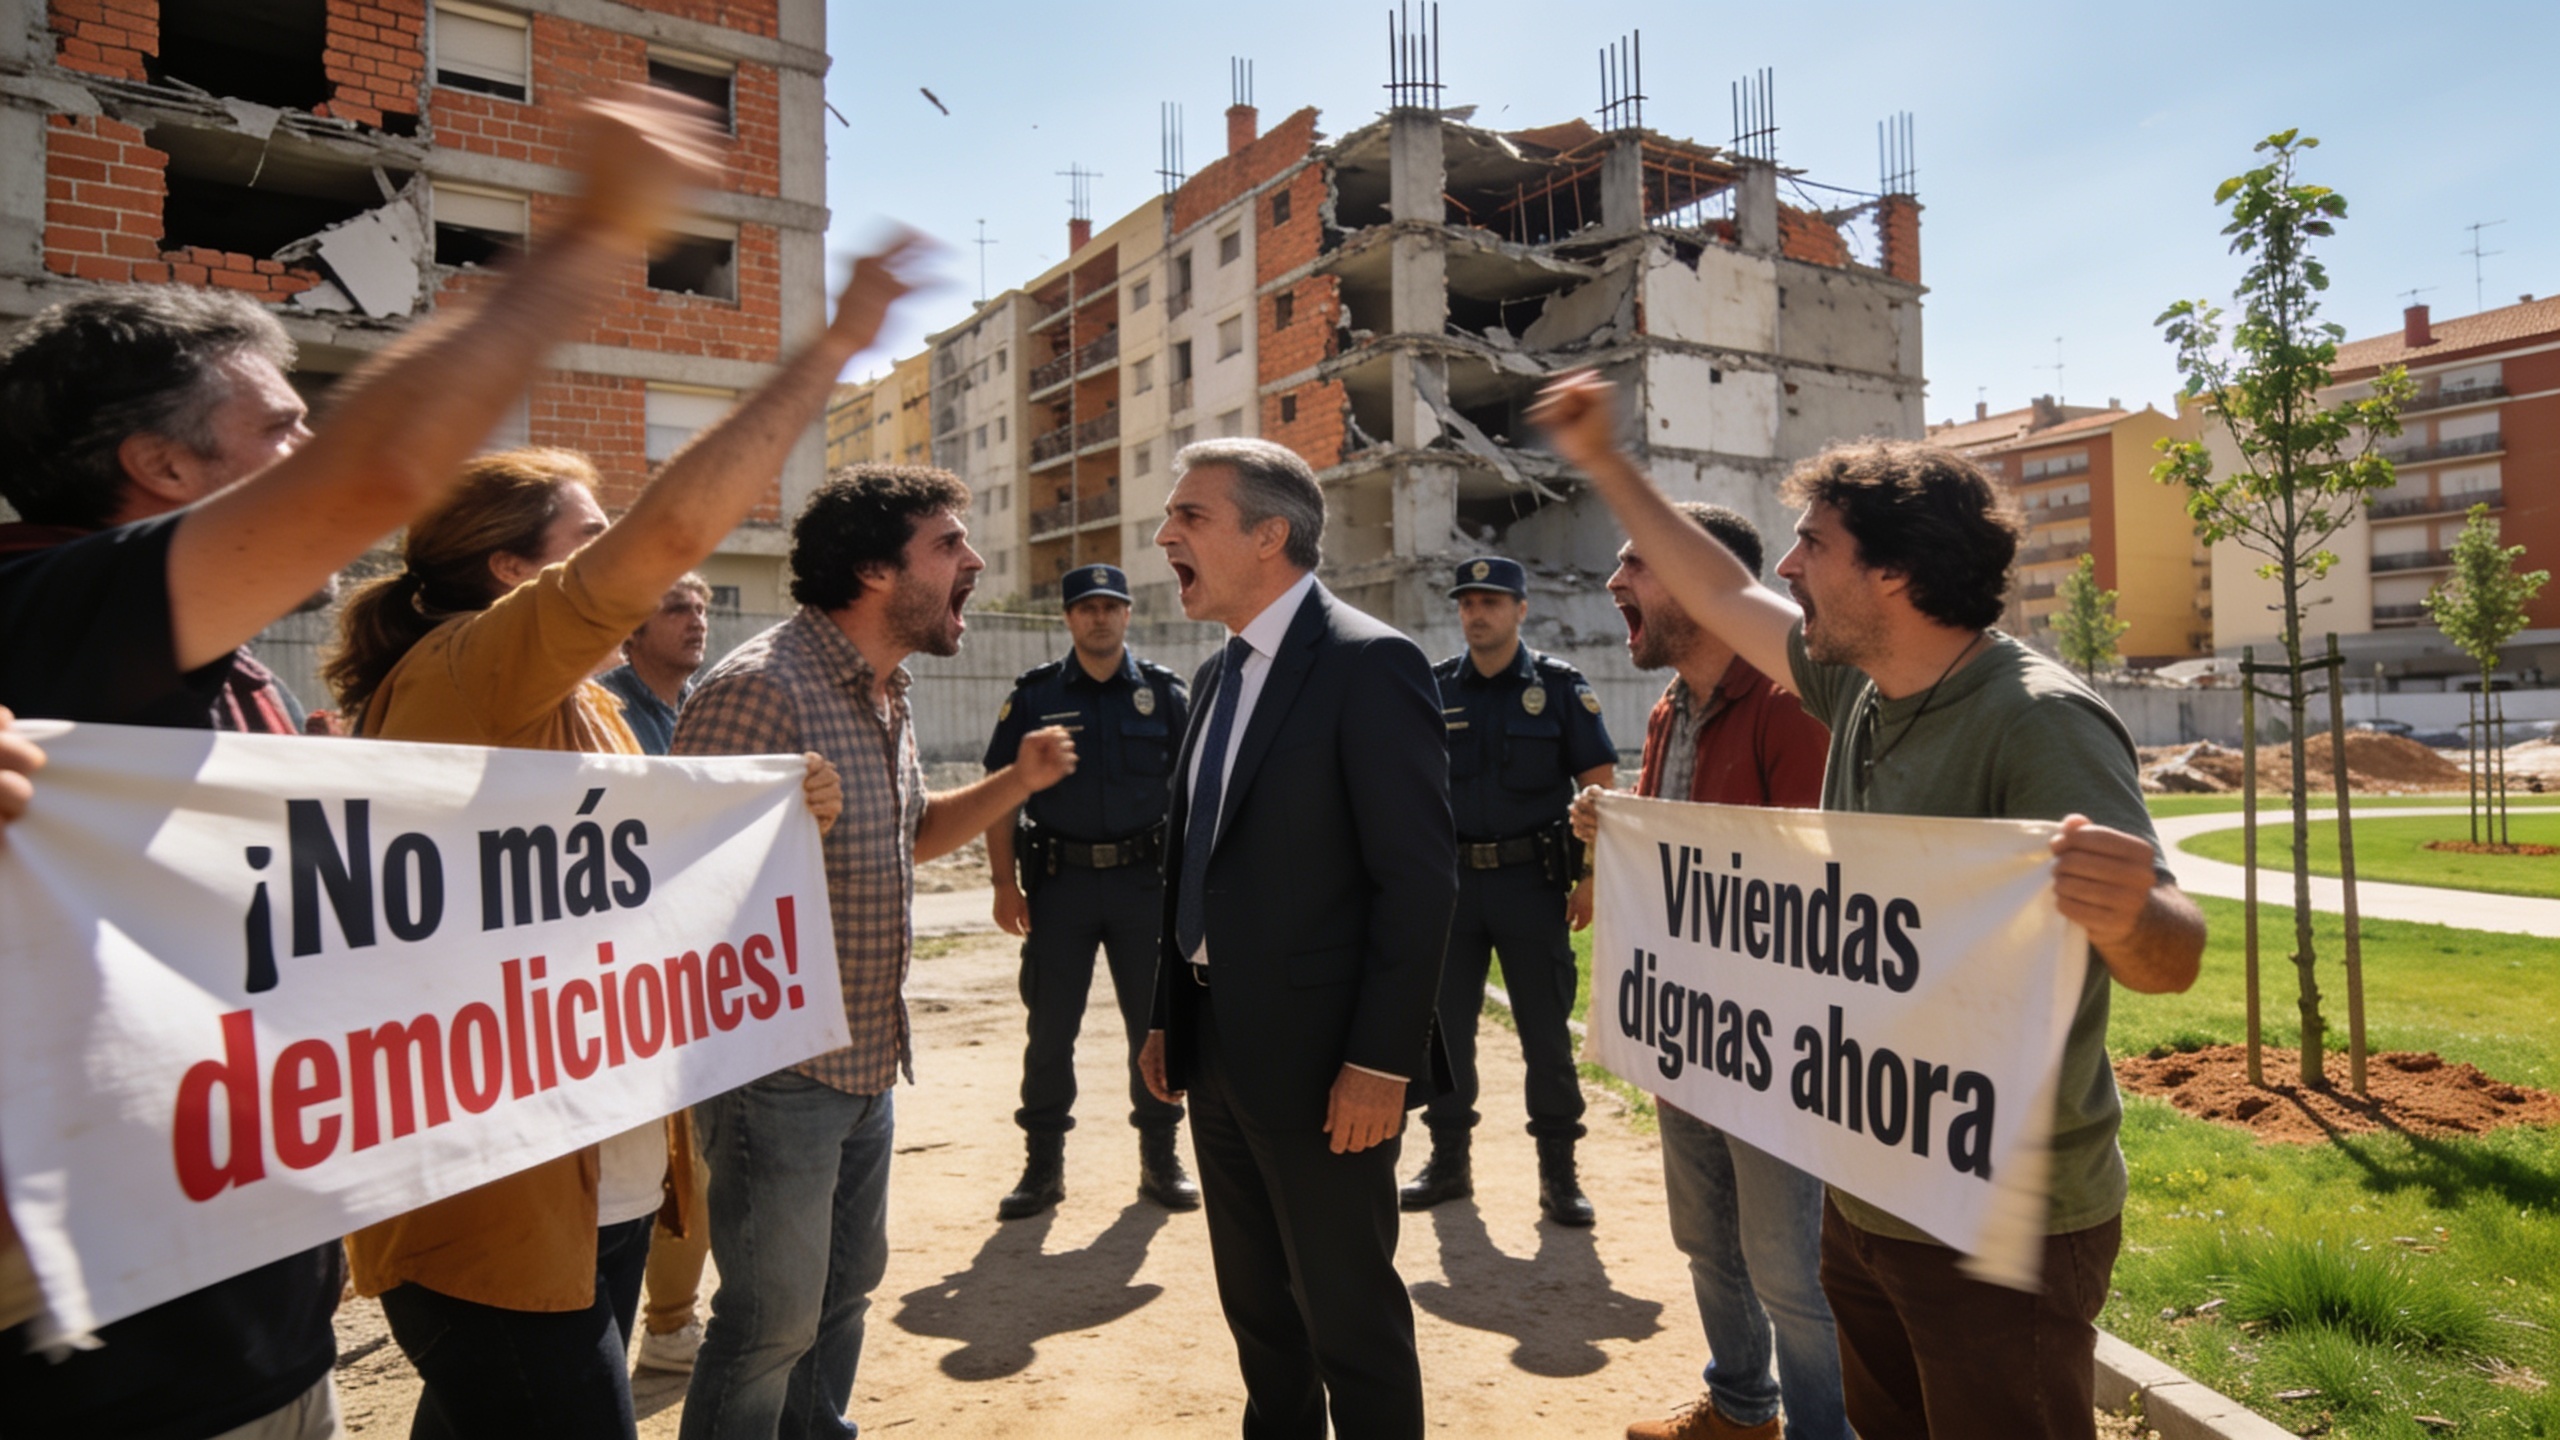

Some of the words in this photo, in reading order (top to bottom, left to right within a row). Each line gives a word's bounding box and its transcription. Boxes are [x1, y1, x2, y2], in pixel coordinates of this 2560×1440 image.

[245, 798, 445, 993] ¡No
[478, 787, 652, 932] más
[1658, 841, 1922, 993] Viviendas
[173, 895, 806, 1203] demoliciones!
[1618, 948, 1773, 1092] dignas
[1790, 1004, 1996, 1181] ahora
